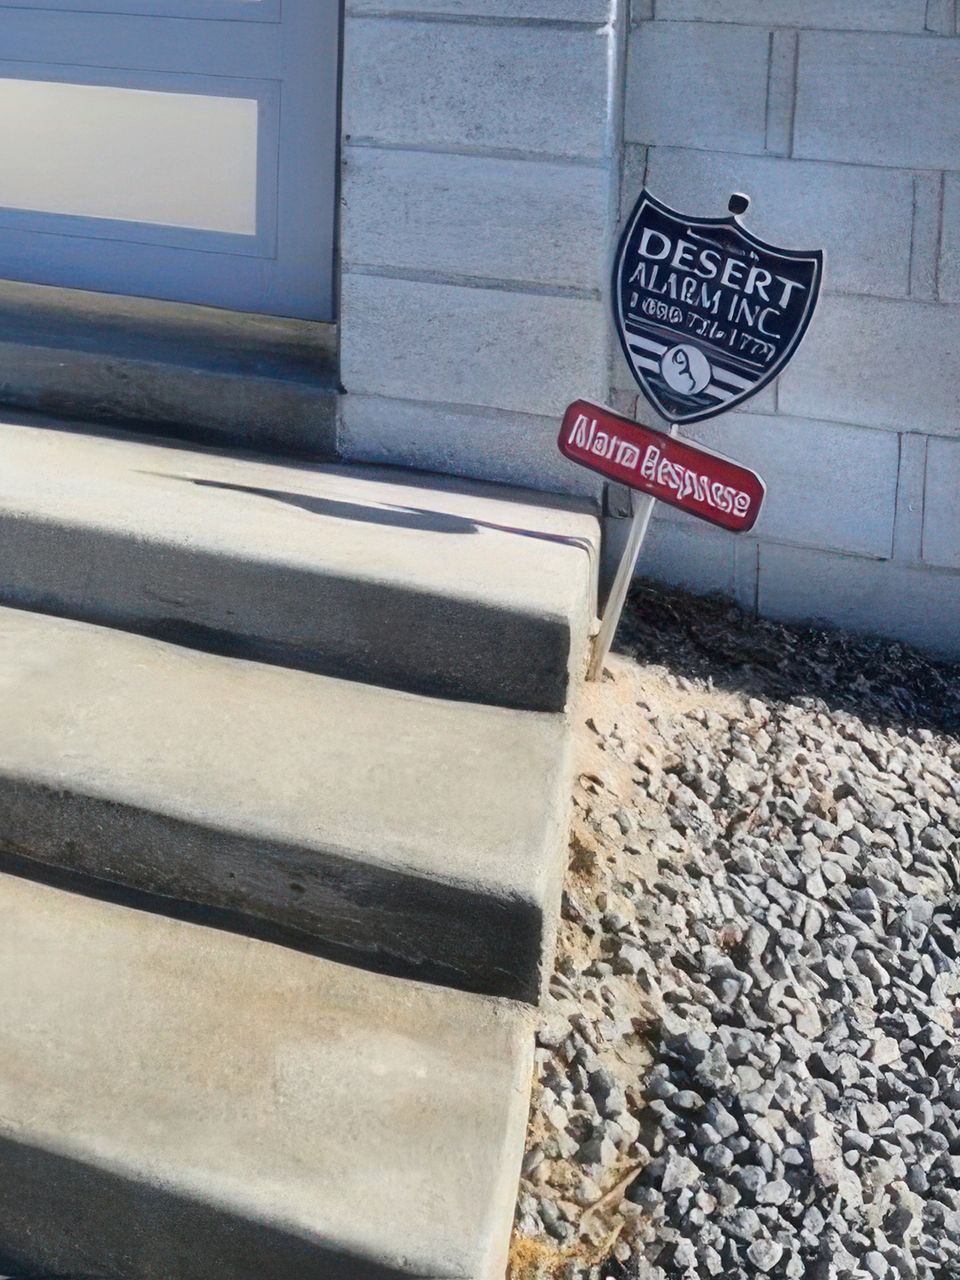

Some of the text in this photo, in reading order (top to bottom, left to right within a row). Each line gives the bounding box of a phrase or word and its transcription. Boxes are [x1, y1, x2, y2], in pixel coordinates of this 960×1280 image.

[629, 261, 722, 314] ALARM
[728, 294, 781, 339] INC
[637, 228, 806, 309] DESERT
